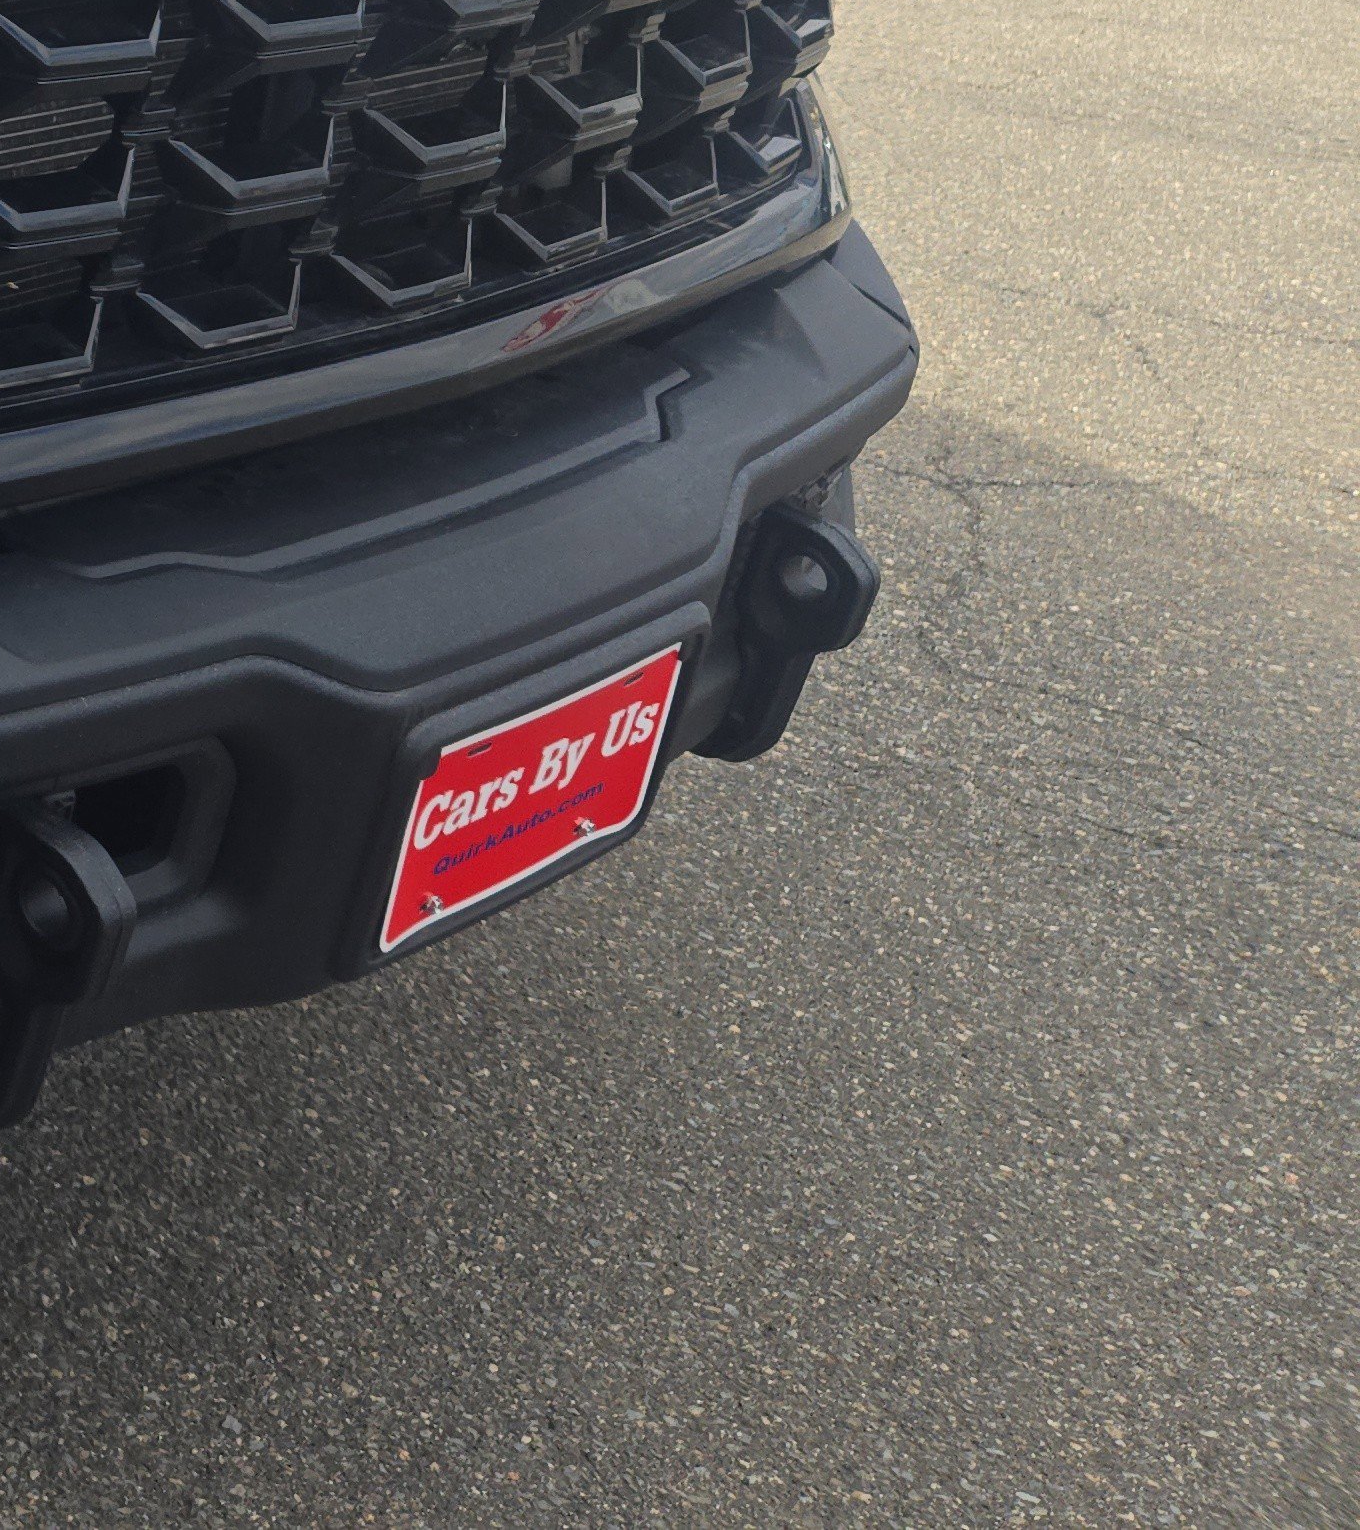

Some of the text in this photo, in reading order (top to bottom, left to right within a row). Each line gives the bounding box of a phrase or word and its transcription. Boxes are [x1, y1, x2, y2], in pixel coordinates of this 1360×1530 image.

[413, 700, 661, 851] Cars By Us
[433, 781, 605, 876] QuirkAuto.com
